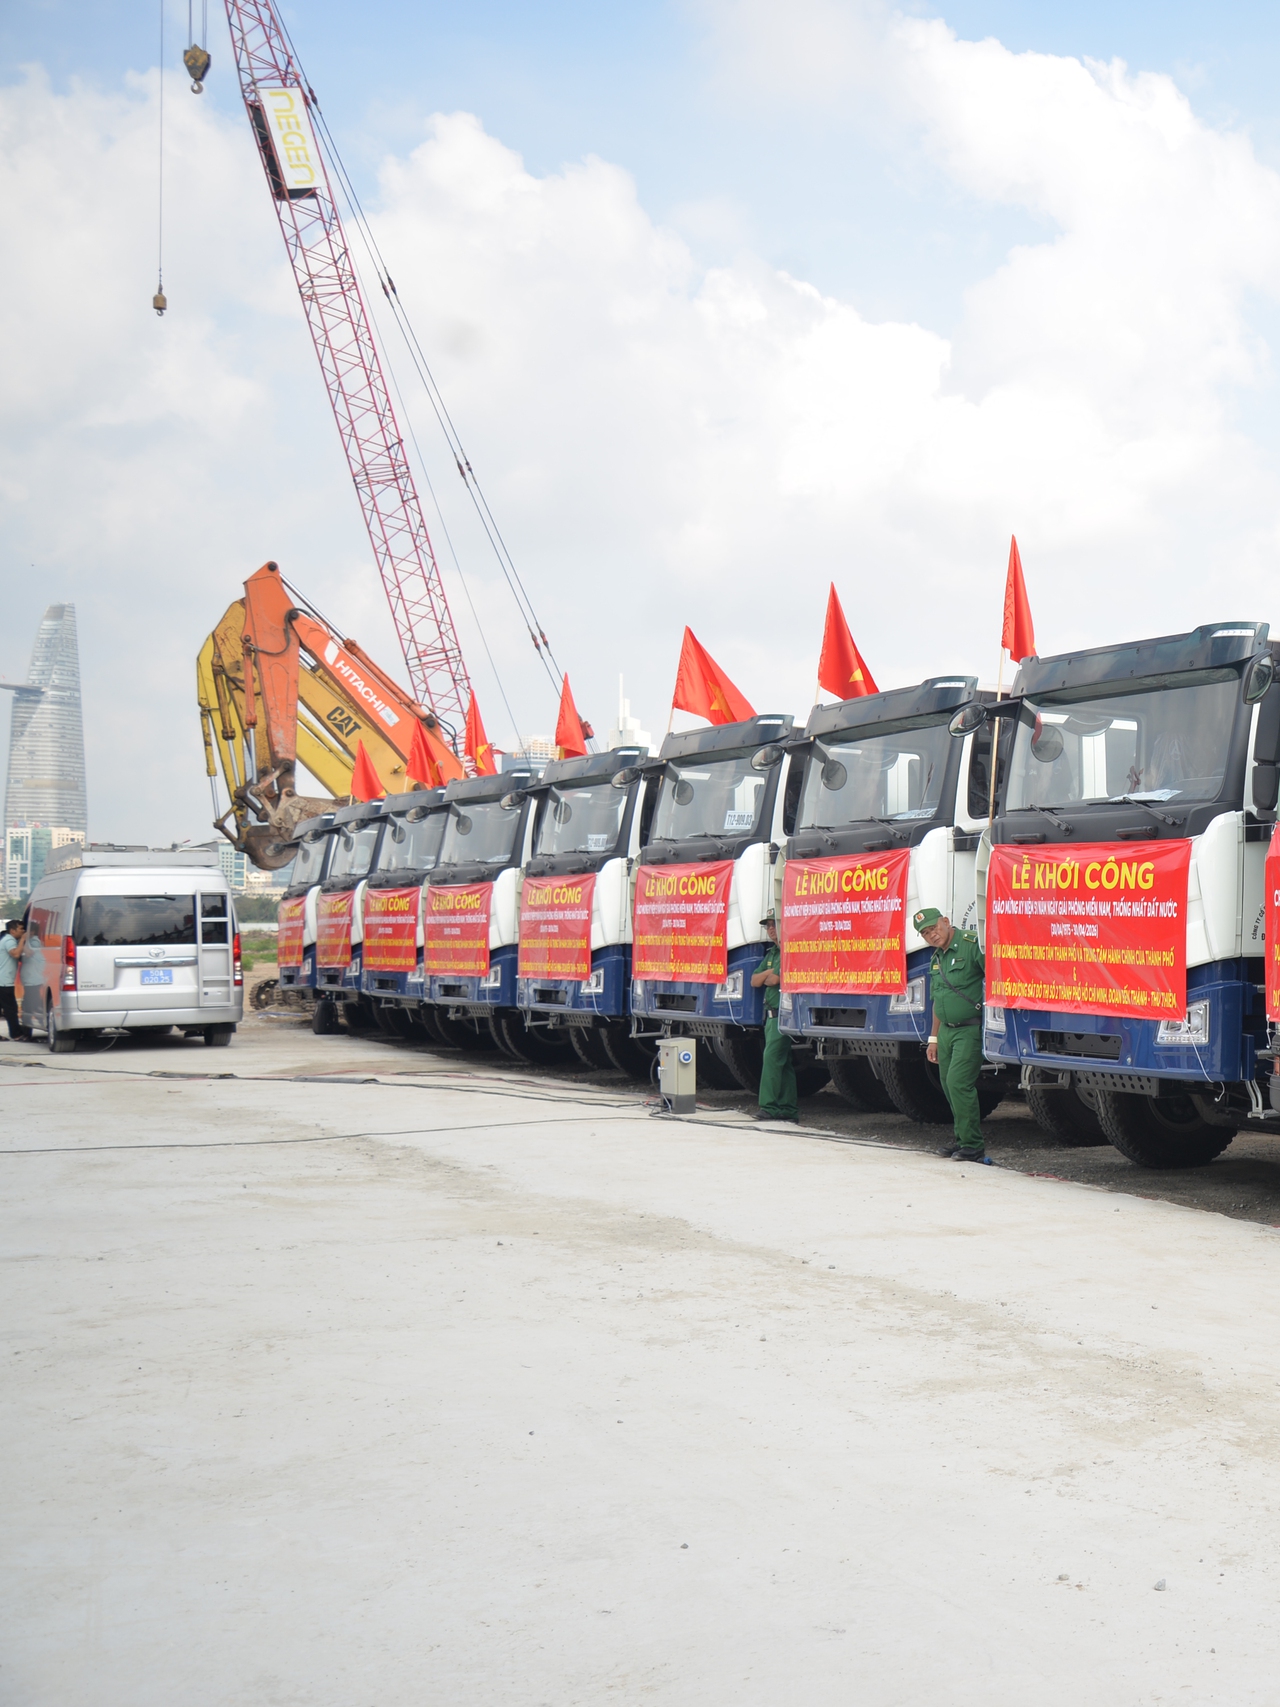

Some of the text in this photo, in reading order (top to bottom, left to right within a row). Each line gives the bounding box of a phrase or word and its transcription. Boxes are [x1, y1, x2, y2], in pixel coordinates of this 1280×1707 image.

[335, 660, 386, 712] HITACHI
[326, 706, 362, 739] CAT
[679, 872, 716, 896] CÔNG
[795, 867, 809, 896] LỄ
[841, 864, 888, 892] CÔNG
[1012, 855, 1031, 889] LỄ
[1085, 856, 1155, 890] CÔNG
[553, 883, 582, 904] CÔNG
